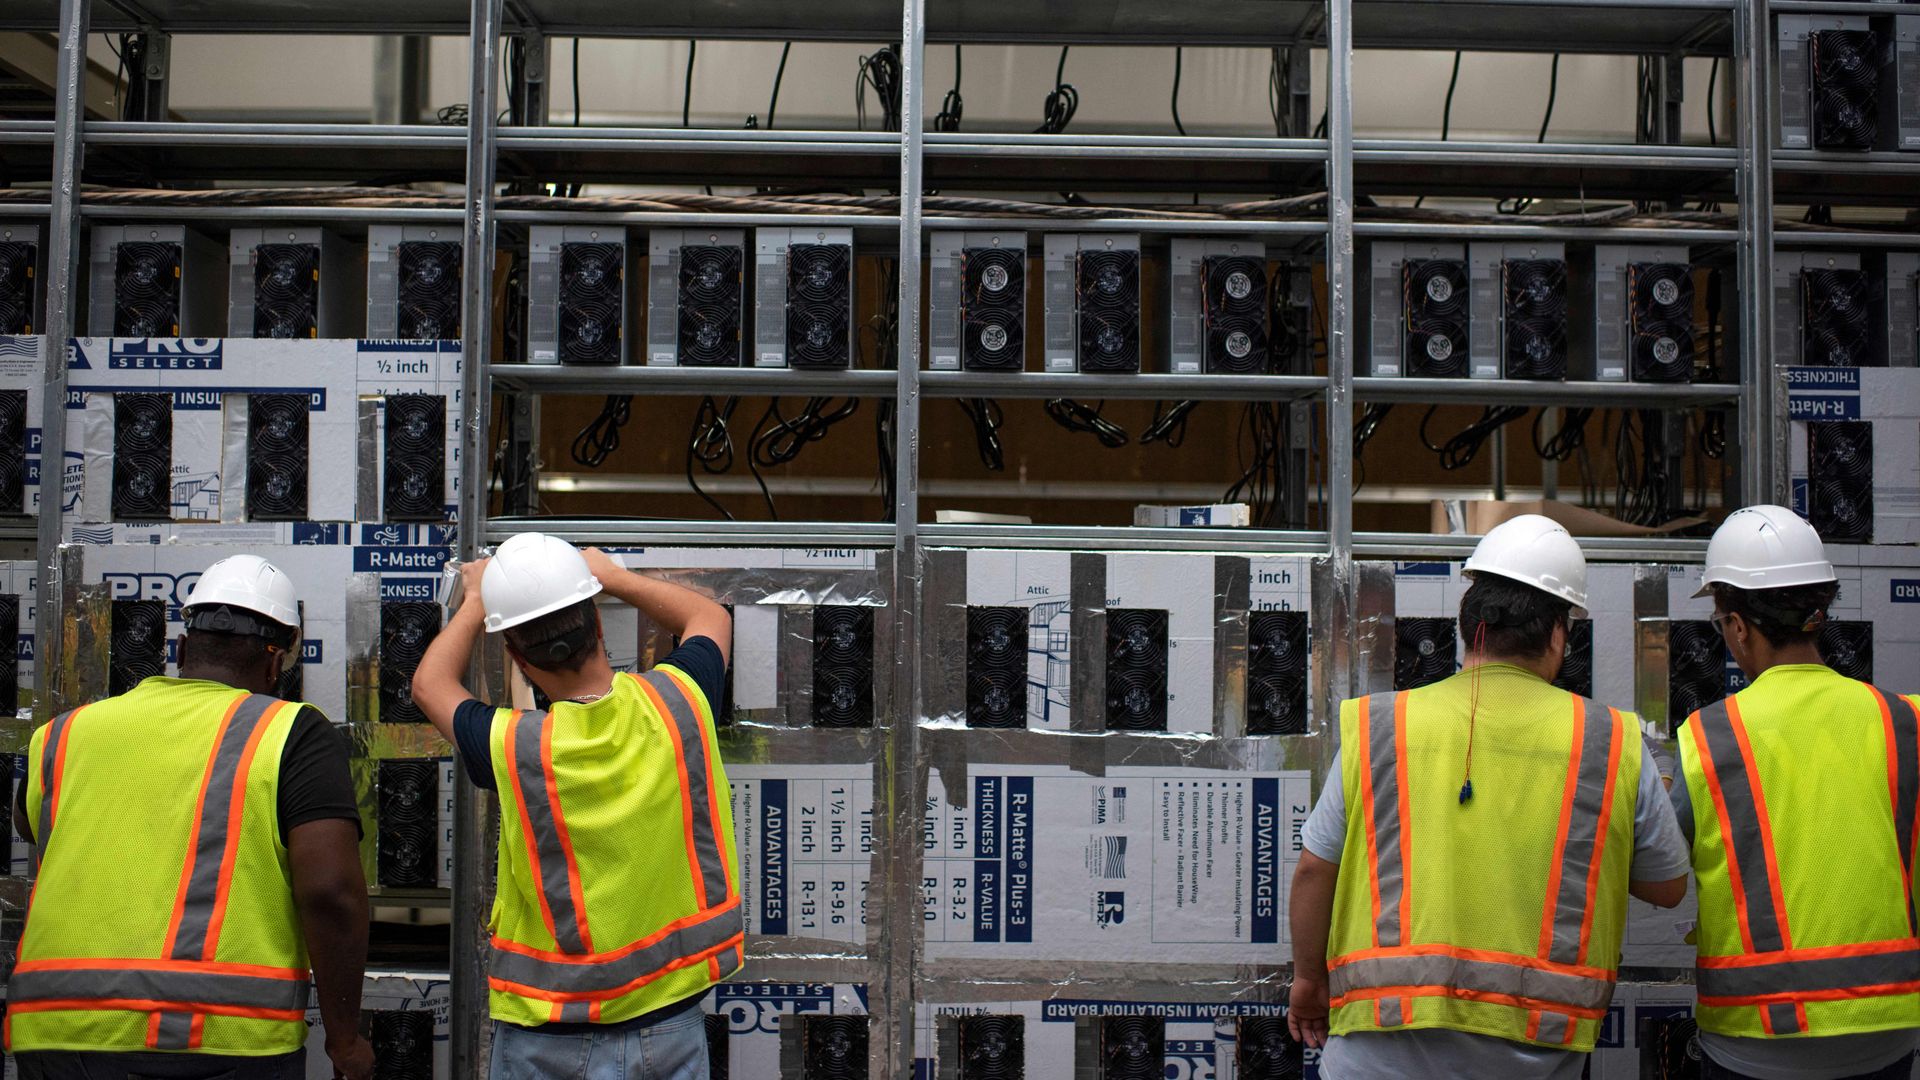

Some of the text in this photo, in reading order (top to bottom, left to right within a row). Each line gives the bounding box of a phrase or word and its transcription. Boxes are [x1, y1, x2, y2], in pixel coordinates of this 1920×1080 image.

[119, 358, 212, 368] SELECT
[397, 359, 428, 373] inch
[1787, 371, 1856, 383] THICKNESS
[1789, 400, 1844, 415] R-Matt
[1259, 569, 1291, 584] inch
[381, 585, 429, 597] CKNESS
[1027, 585, 1050, 595] Attic
[1105, 597, 1121, 607] oof
[1258, 599, 1290, 611] inch
[743, 793, 751, 816] Higher
[1098, 798, 1106, 824] PIMA
[1162, 791, 1170, 808] Easy
[1234, 791, 1242, 815] Higher
[1292, 805, 1306, 814] 2
[981, 780, 994, 854] THICKNESS
[1162, 818, 1170, 841] Install
[802, 807, 816, 853] 2 inch
[831, 820, 846, 853] inch
[924, 817, 938, 850] inch
[953, 817, 968, 850] inch
[767, 805, 782, 920] ADVANTAGES
[1257, 803, 1272, 918] ADVANTAGES
[1190, 862, 1198, 904] HouseWrap
[743, 881, 752, 917] Insulating
[802, 881, 815, 928] R-13.1
[831, 881, 845, 924] R-9.6
[923, 878, 937, 921] R-5.0
[953, 878, 967, 920] R-3.2
[981, 873, 994, 930] R-VALUE
[1011, 874, 1027, 925] Plus-3
[1233, 879, 1242, 914] Insulating
[1234, 915, 1242, 938] Power
[726, 985, 823, 995] SELECT
[1047, 1004, 1289, 1017] MANCE FOAM INSULATION BOARD
